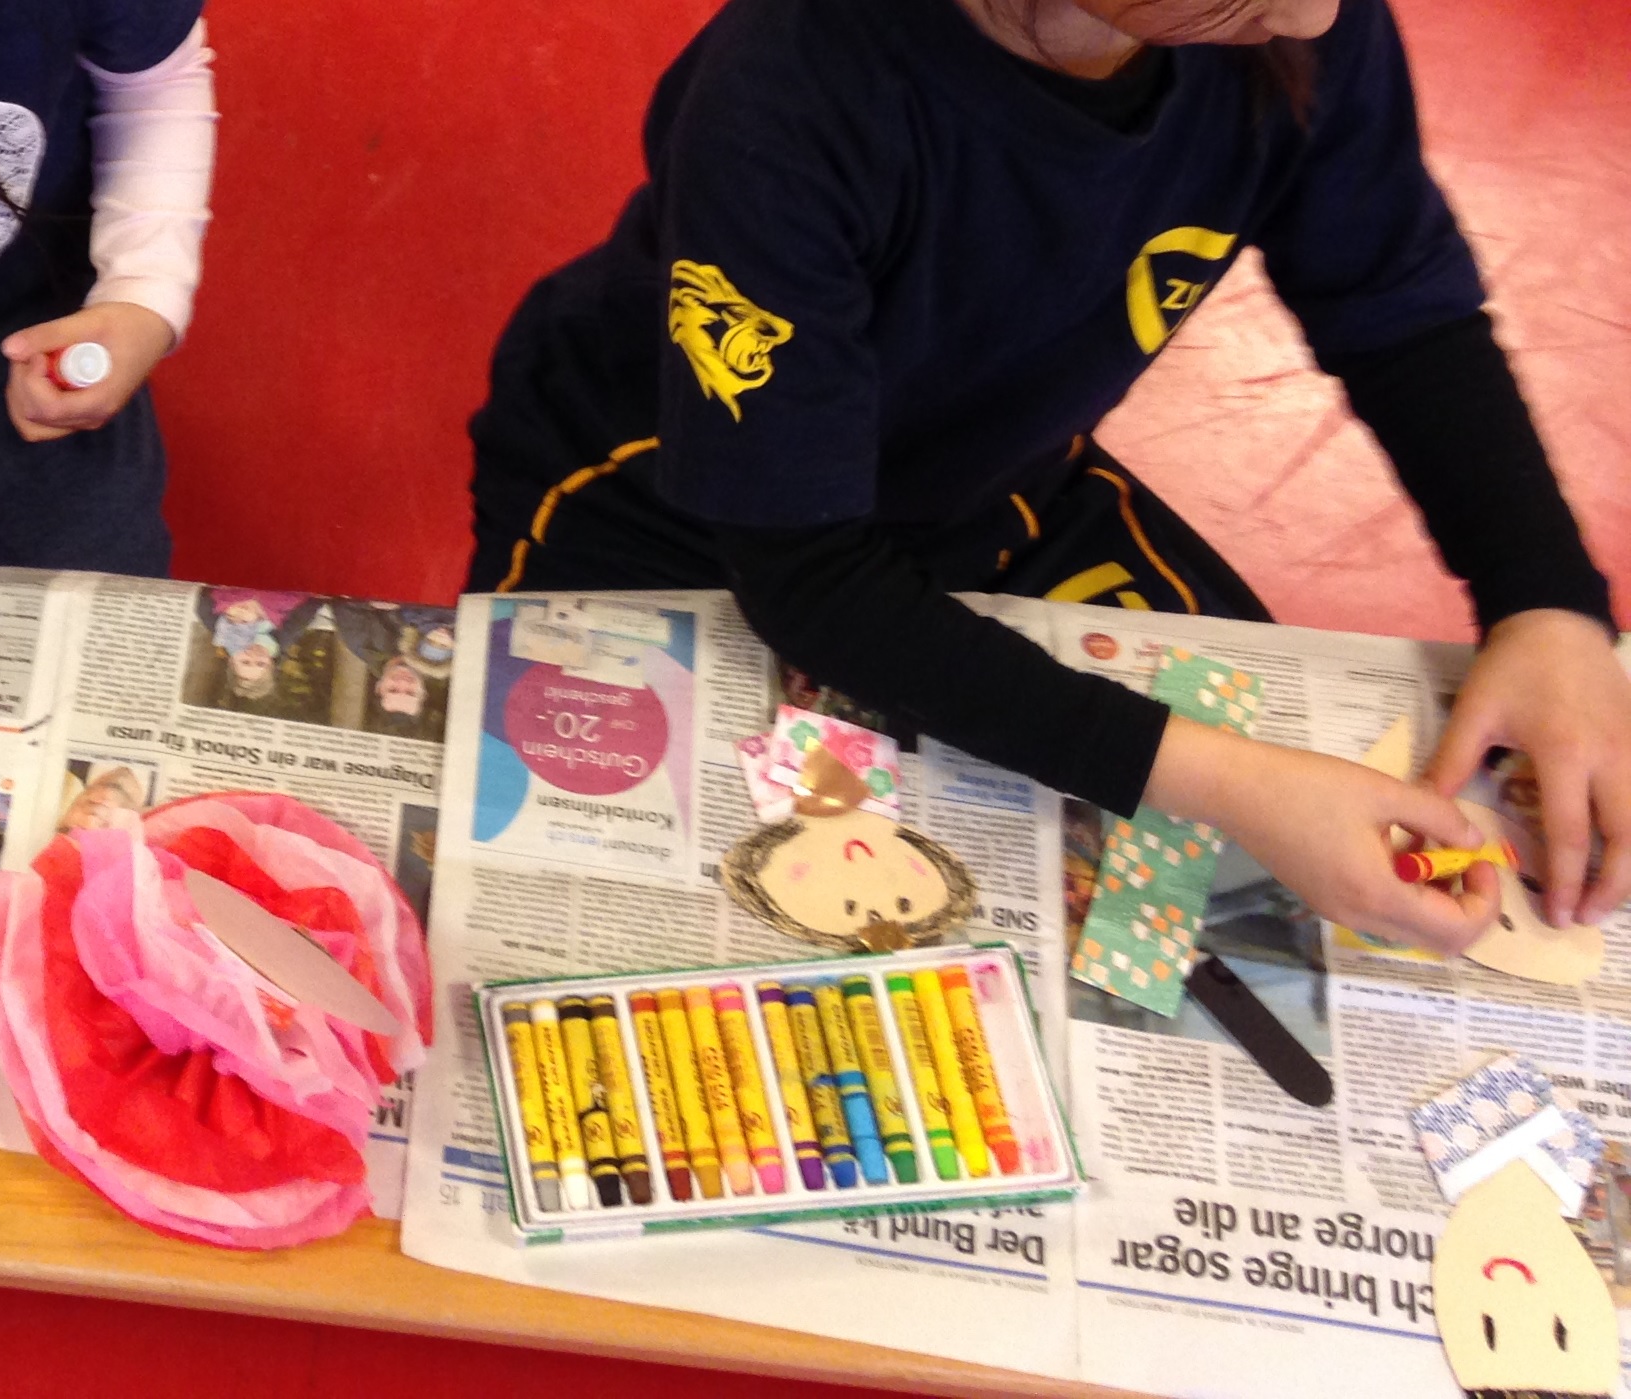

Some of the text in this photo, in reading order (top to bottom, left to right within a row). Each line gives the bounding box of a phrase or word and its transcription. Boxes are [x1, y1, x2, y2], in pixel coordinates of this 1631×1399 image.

[157, 732, 187, 753] für
[192, 736, 261, 766] Schock
[266, 749, 297, 769] ein
[521, 741, 648, 778] Gutschein
[301, 754, 338, 772] war
[342, 758, 438, 790] Diagnose
[536, 794, 677, 832] Kontaktlinsen
[991, 906, 1040, 933] SNB
[889, 1214, 977, 1256] Bund
[1172, 1196, 1237, 1242] die
[1249, 1206, 1301, 1241] an
[983, 1227, 1047, 1267] Der
[1111, 1233, 1232, 1283] sogar
[1242, 1249, 1380, 1317] bringe
[1389, 1277, 1435, 1323] ch
